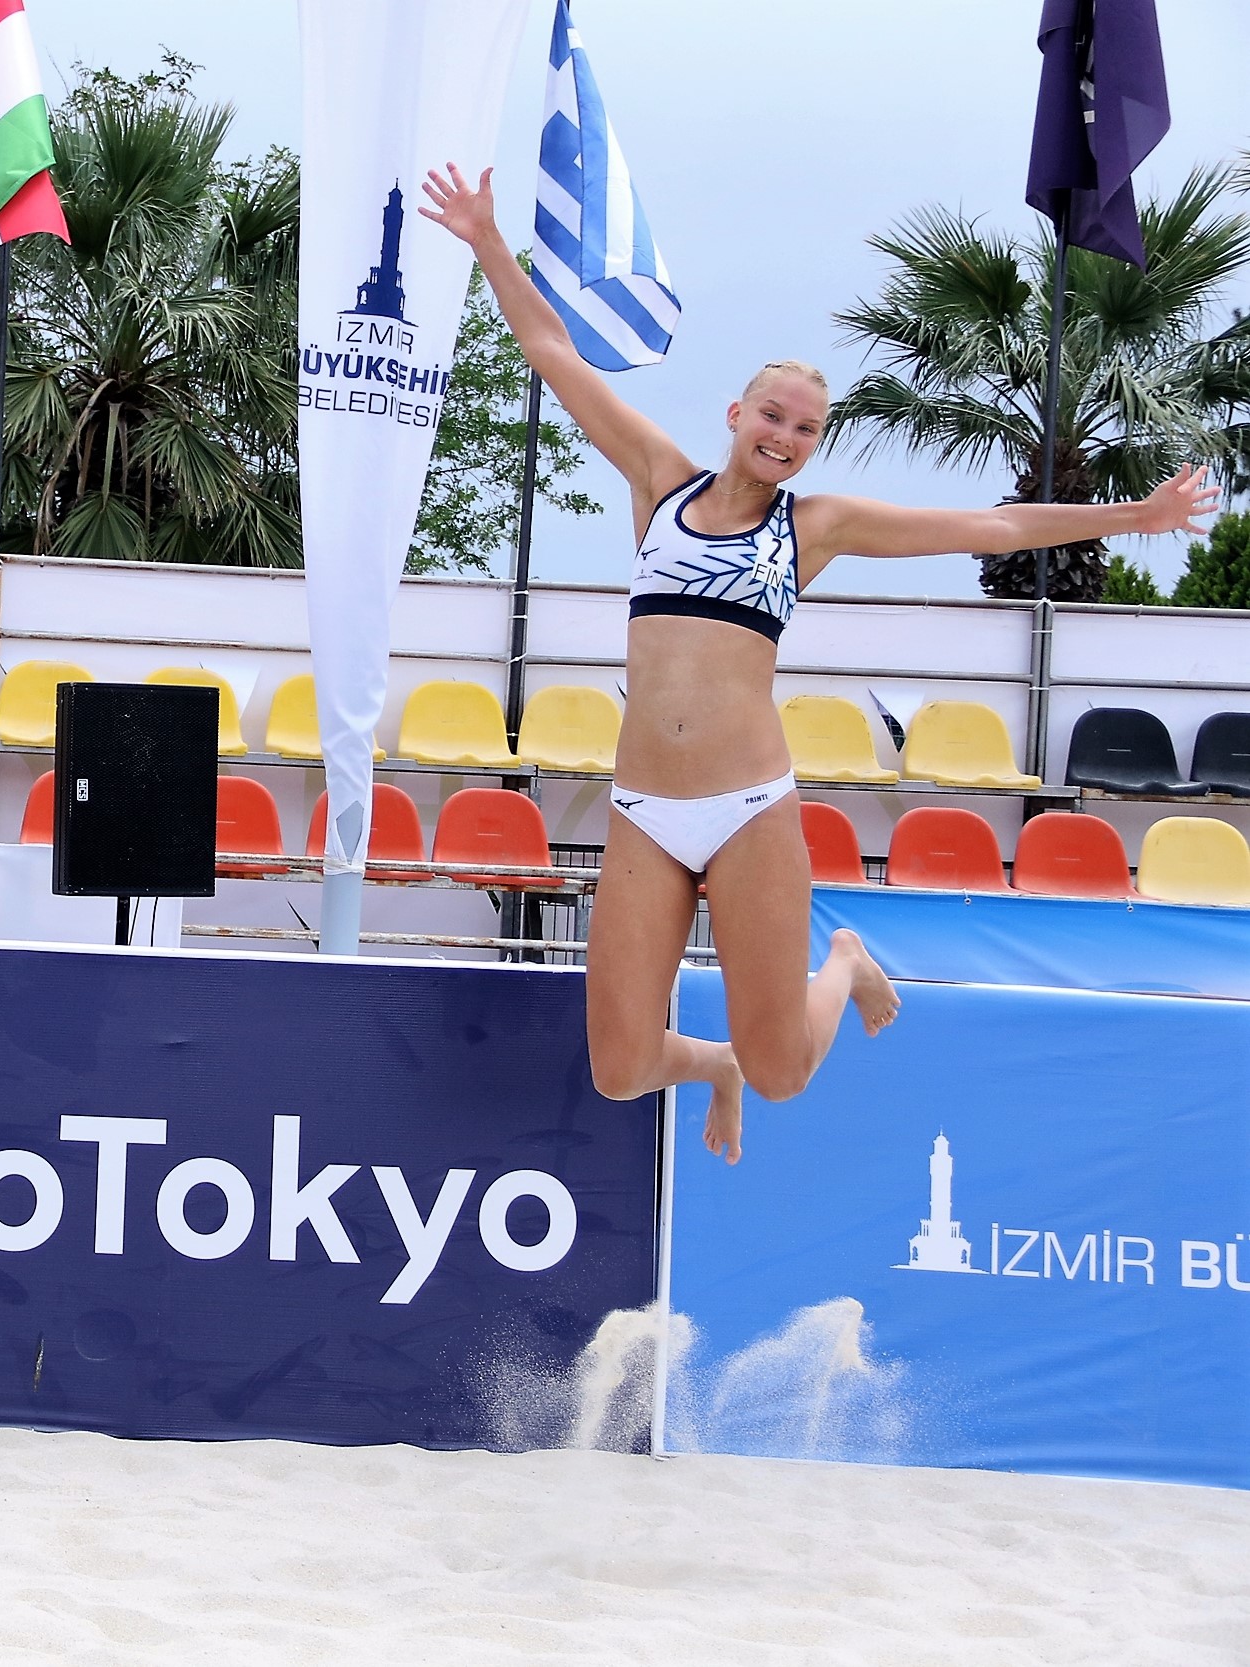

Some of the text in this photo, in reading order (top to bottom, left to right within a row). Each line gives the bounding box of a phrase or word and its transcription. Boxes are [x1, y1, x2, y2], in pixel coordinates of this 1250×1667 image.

[768, 538, 782, 565] 2
[754, 563, 783, 588] FIN
[990, 1222, 1155, 1285] İZMİR
